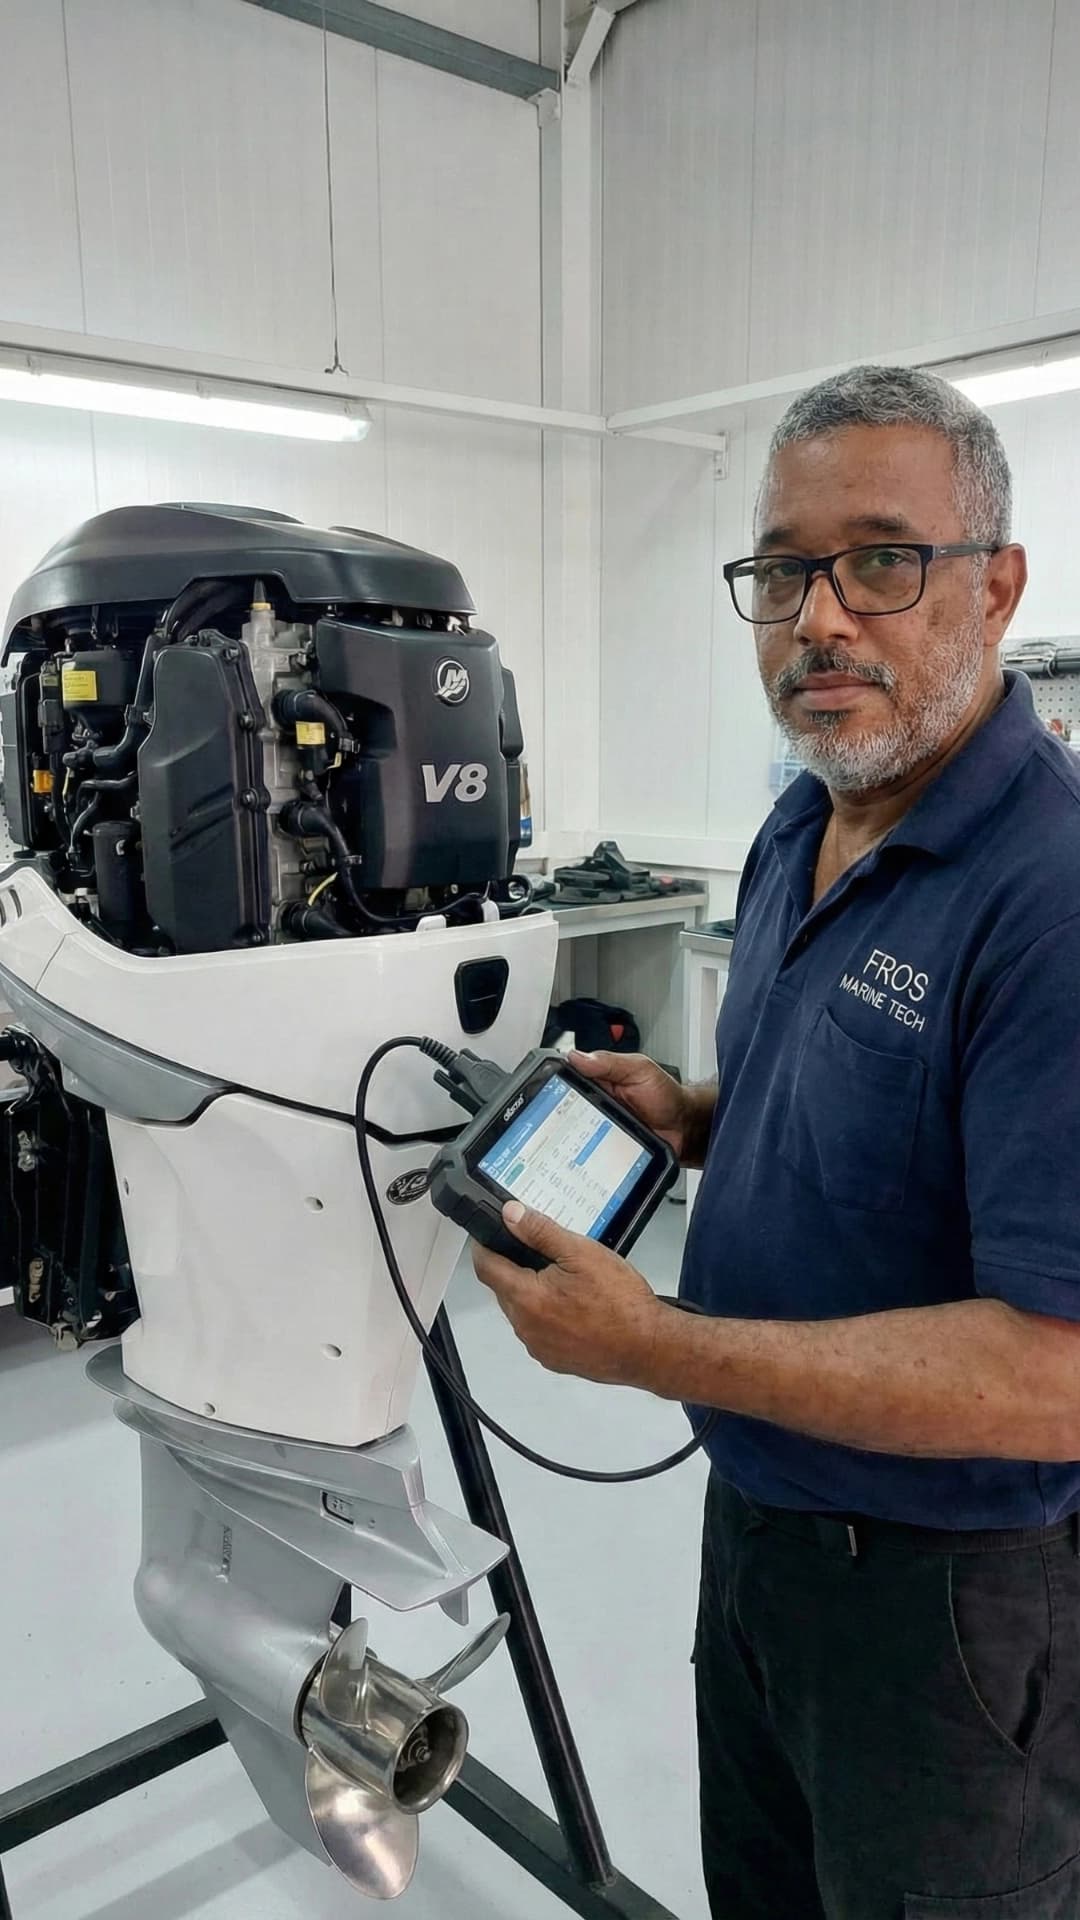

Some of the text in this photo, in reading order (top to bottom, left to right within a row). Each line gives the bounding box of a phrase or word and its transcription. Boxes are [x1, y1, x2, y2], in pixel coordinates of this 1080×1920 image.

[421, 763, 488, 802] V8
[863, 949, 928, 1001] FROS
[839, 974, 925, 1032] MARINE TECH
